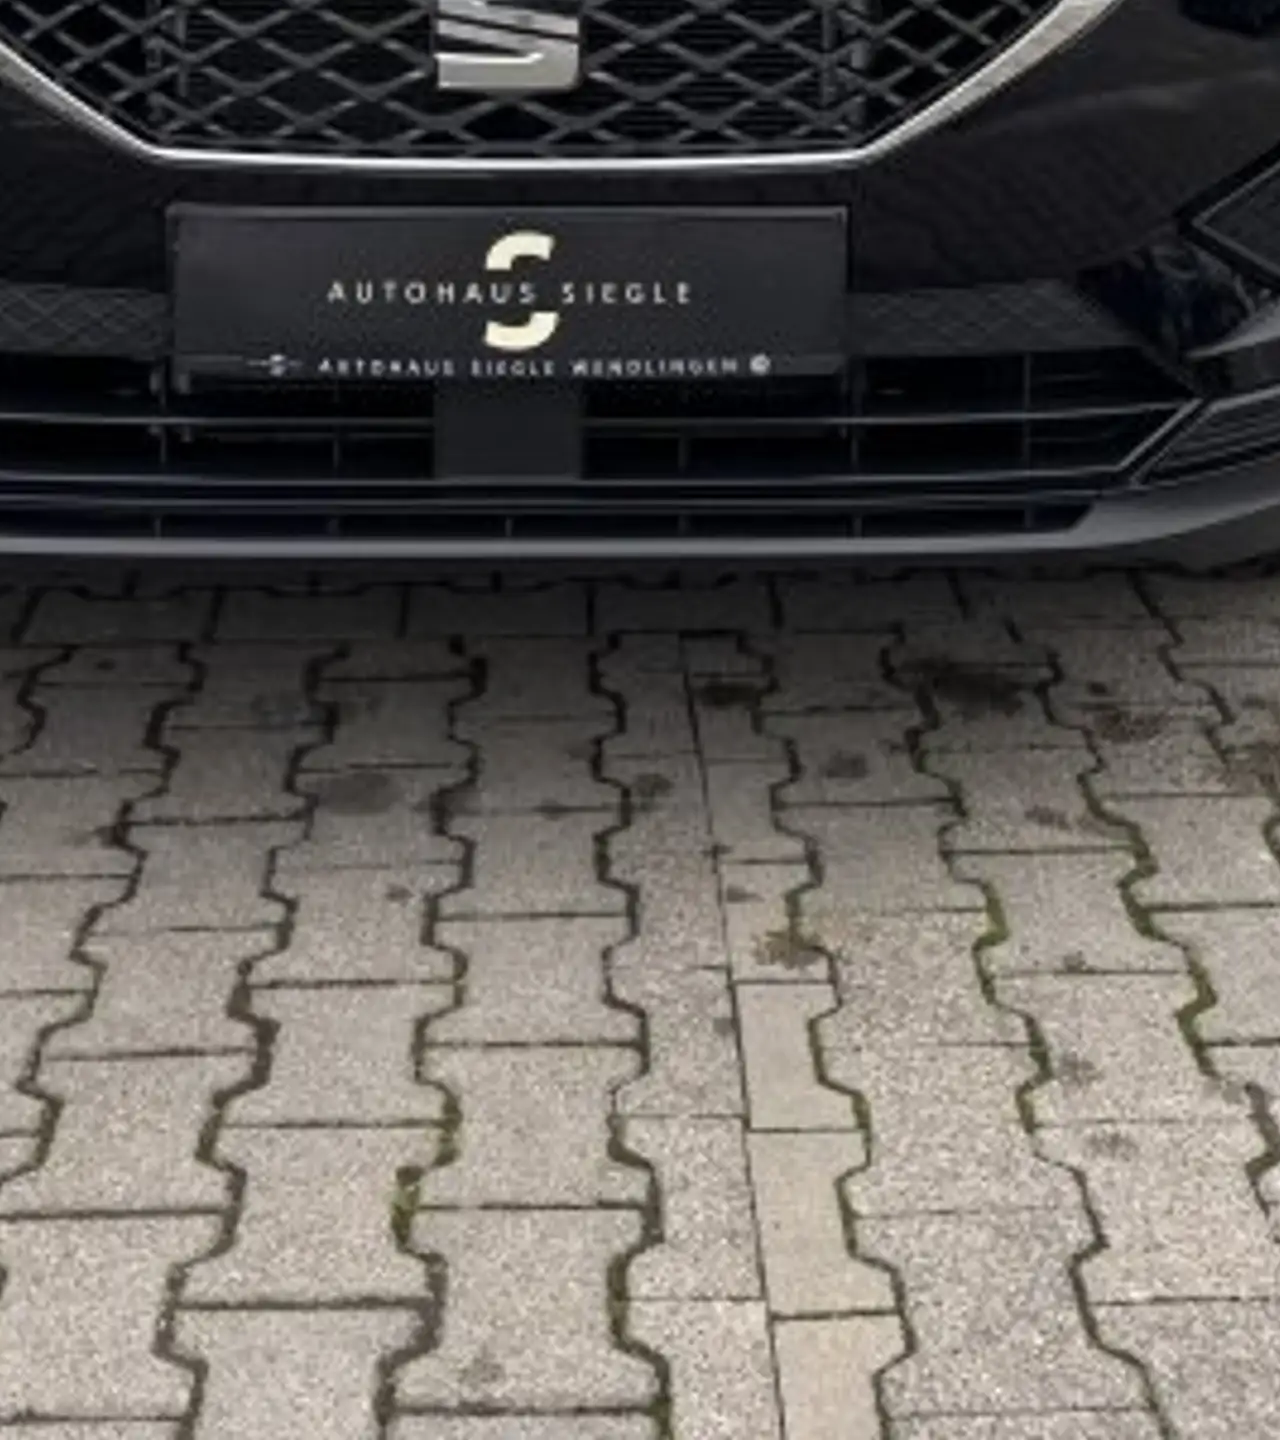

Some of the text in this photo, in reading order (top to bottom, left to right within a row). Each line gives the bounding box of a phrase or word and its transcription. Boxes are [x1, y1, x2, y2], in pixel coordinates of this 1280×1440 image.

[326, 280, 694, 305] AUTOHAUS SIEGLE
[316, 357, 740, 377] AUTOHAUS SIEGLE WENDLINGEN
